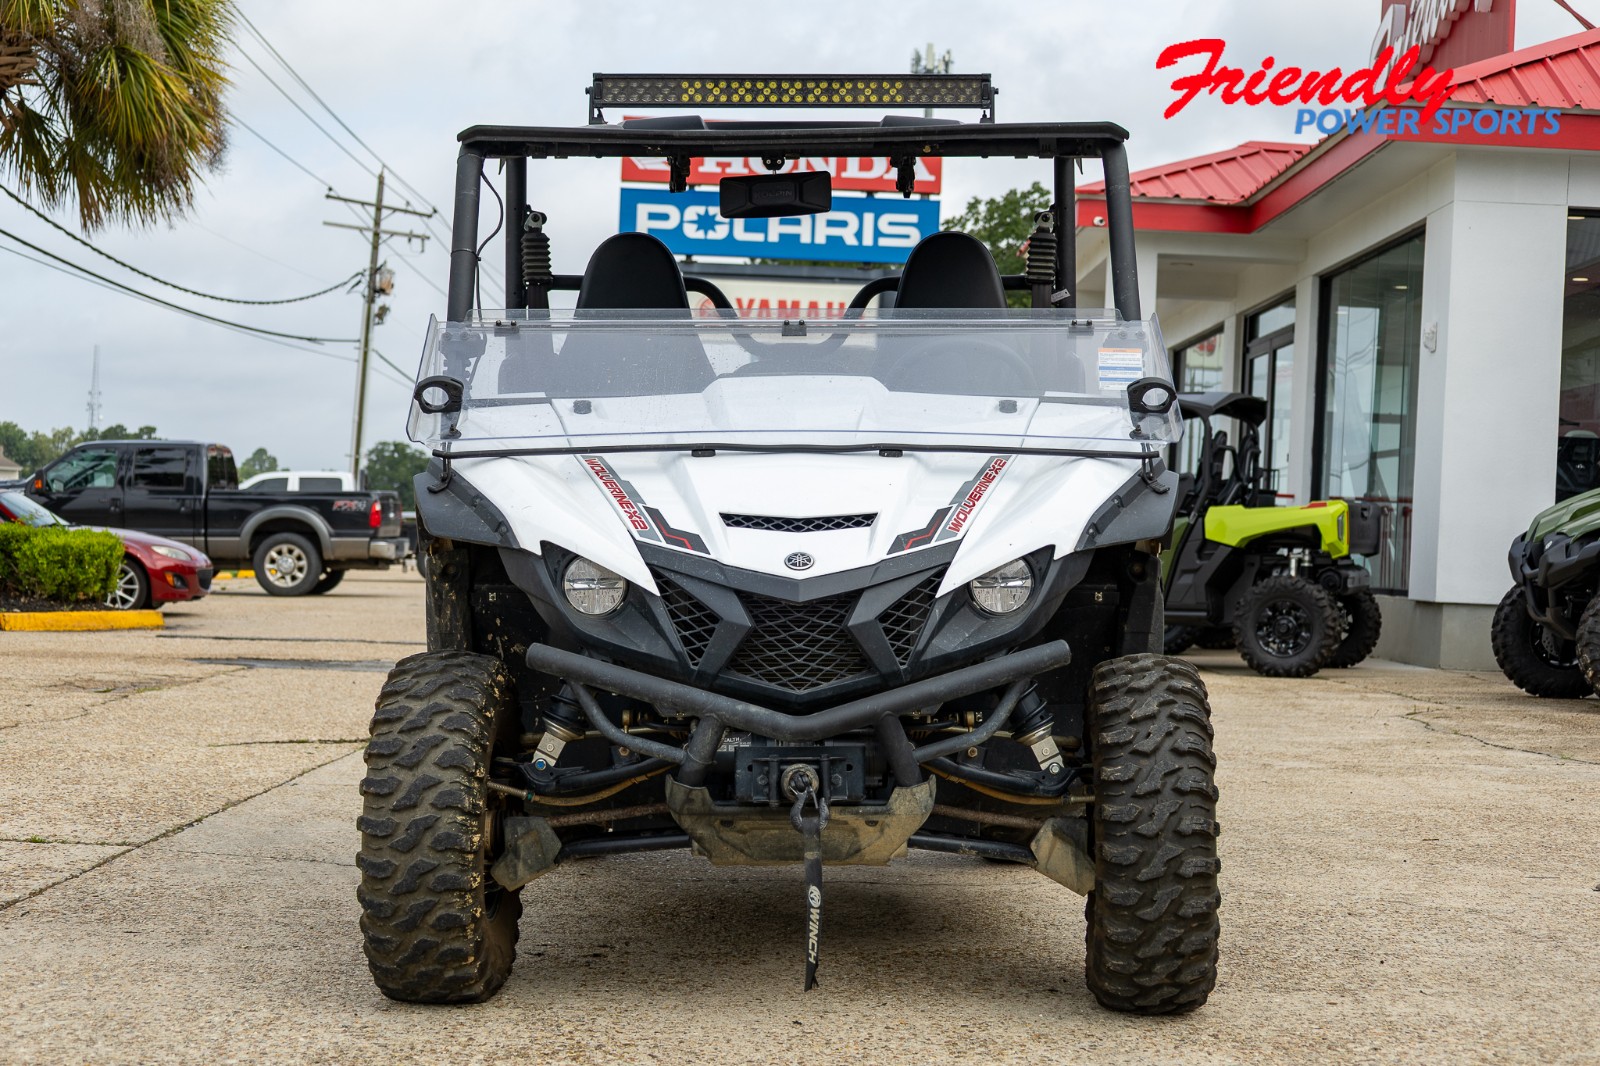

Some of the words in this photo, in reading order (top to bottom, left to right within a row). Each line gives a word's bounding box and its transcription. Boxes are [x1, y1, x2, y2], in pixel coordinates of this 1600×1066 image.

[636, 203, 921, 247] POLARIS
[736, 297, 864, 321] YAMAH
[808, 908, 820, 964] WINCH
